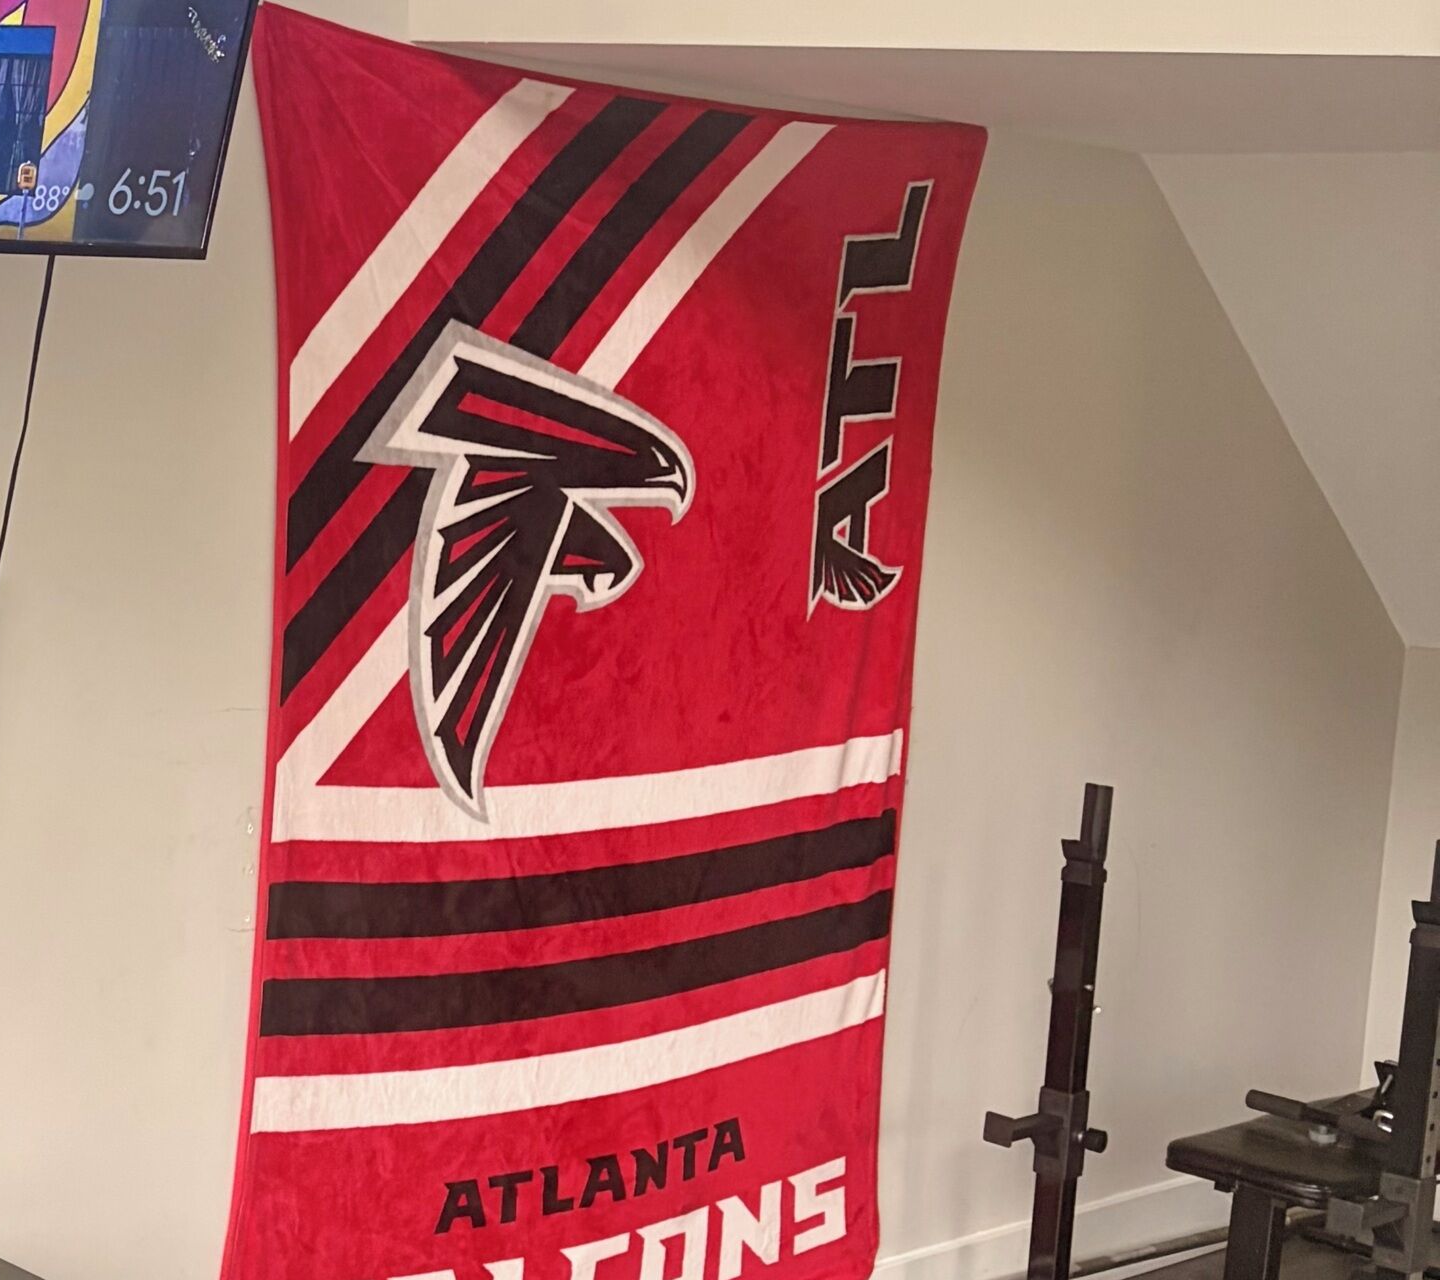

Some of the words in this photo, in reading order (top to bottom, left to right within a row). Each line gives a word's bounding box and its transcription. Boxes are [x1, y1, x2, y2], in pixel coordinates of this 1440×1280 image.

[108, 167, 187, 217] 6:51
[807, 178, 935, 622] ATL
[433, 1117, 747, 1235] ATLANTA
